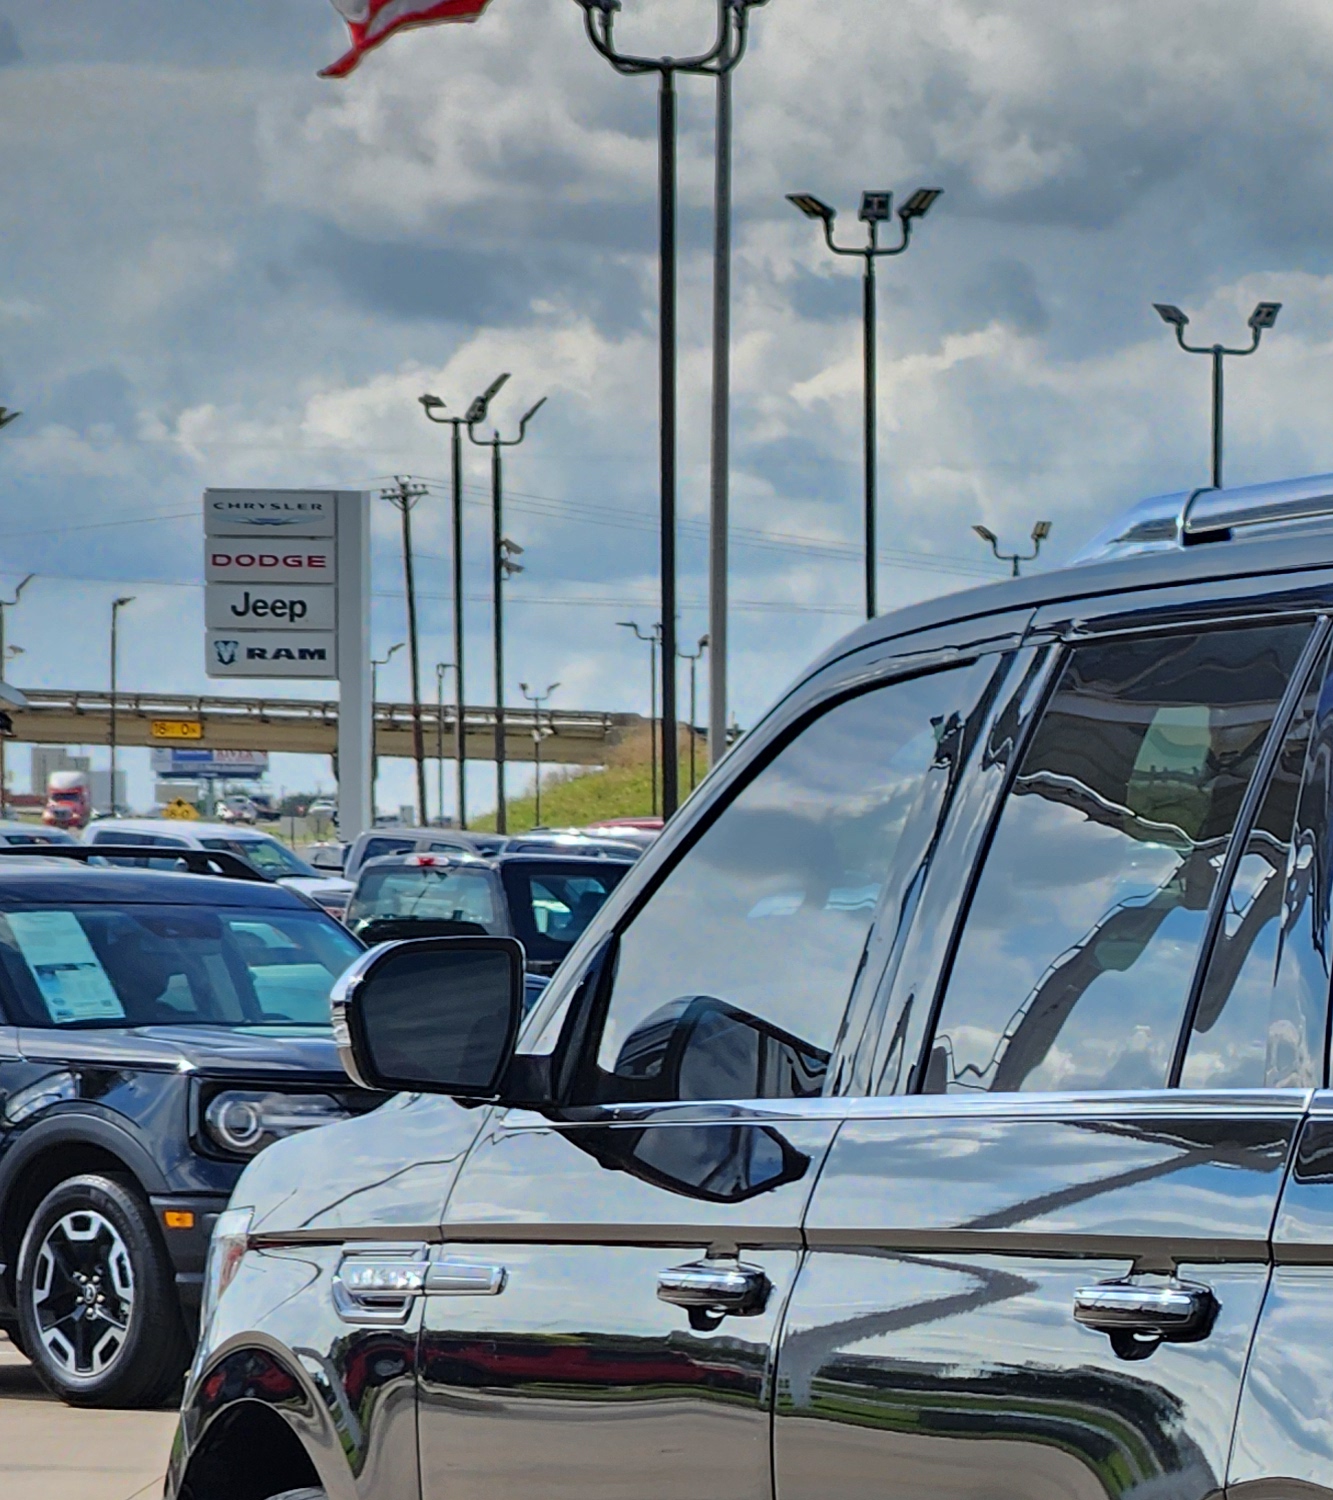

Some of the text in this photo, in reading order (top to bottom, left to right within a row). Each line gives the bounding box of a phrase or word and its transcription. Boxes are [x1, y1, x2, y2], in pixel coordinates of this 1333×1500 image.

[213, 502, 323, 511] CHRYSLER
[211, 553, 327, 568] DODGE
[230, 591, 307, 623] Jeep
[246, 647, 327, 661] RAM
